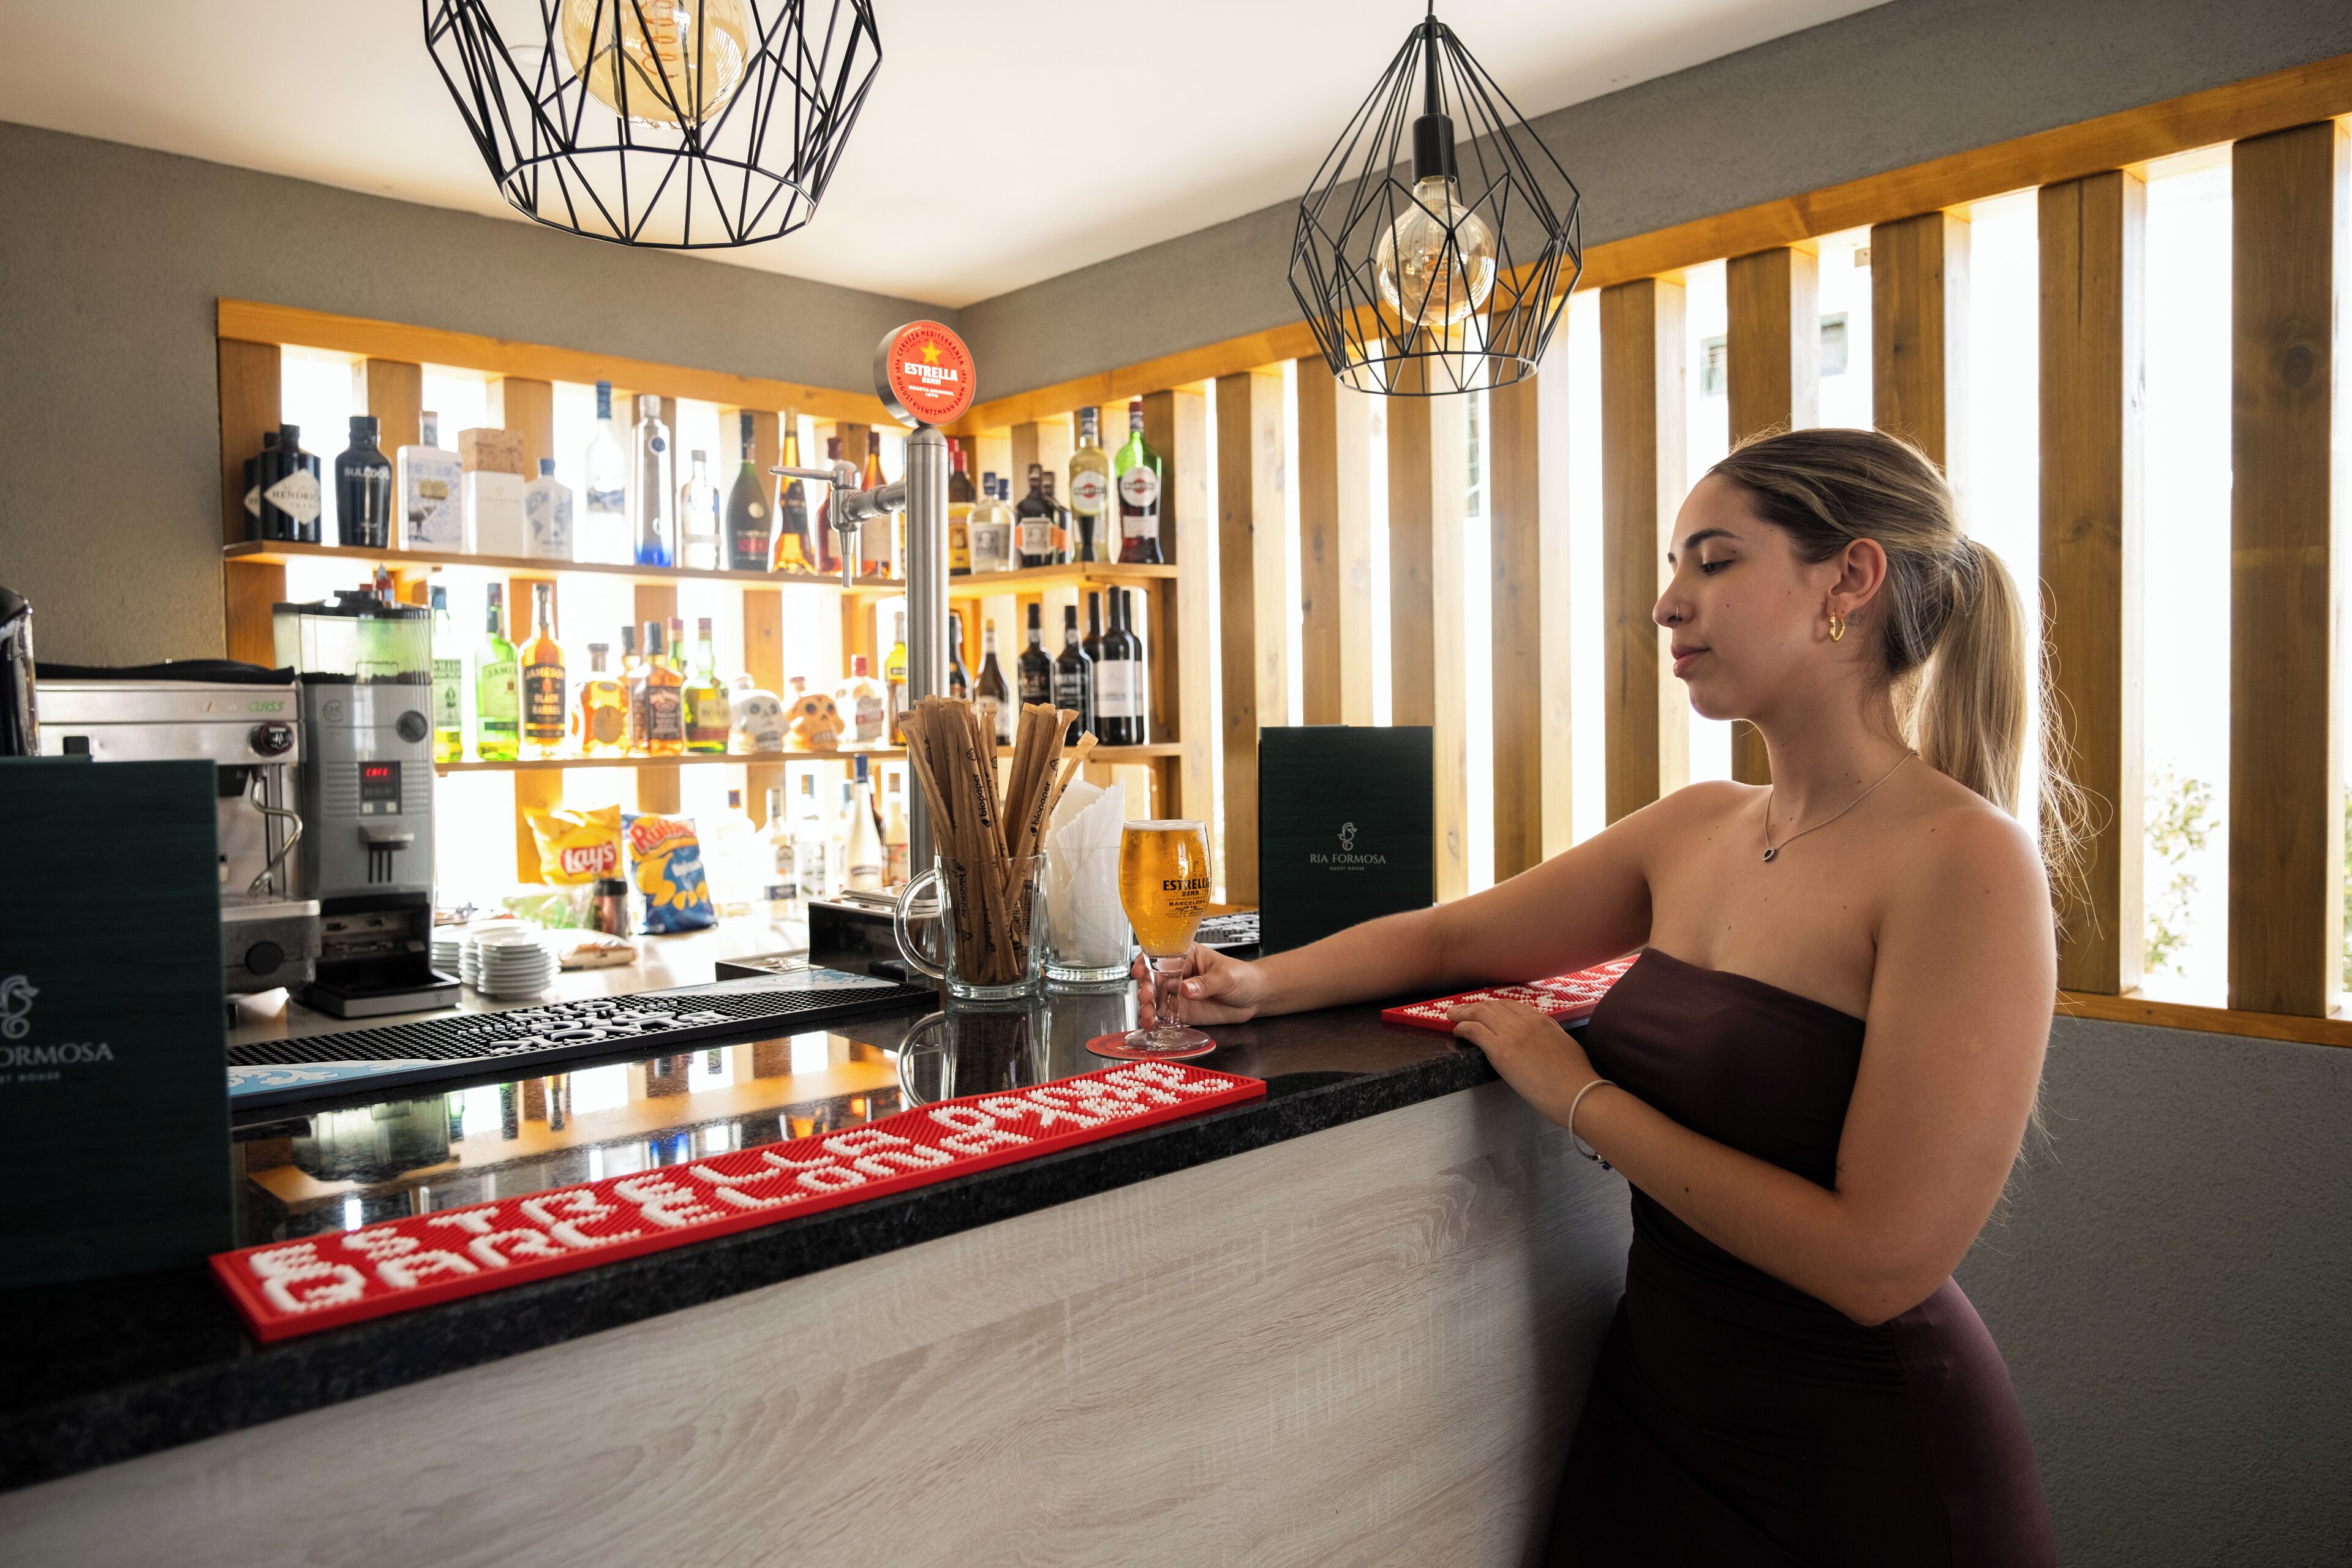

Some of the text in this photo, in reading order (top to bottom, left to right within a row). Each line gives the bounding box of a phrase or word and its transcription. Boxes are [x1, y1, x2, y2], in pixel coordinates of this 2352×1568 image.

[897, 332, 919, 356] CERVEZA
[904, 362, 958, 382] ESTRELLA
[921, 377, 941, 385] DAMM
[896, 375, 913, 403] AUGUST
[913, 401, 956, 416] KUENTZMANN
[954, 387, 967, 407] DAMM
[929, 388, 955, 396] ORIGINAL
[973, 773, 987, 818] biopaper
[1033, 780, 1052, 826] biopaper
[564, 842, 615, 875] Lay's
[1332, 853, 1386, 864] FORMOSA
[506, 1001, 617, 1021] GIN
[490, 1011, 734, 1055] BLACK
[248, 1062, 1186, 1278] ESTRELLA DAMM
[262, 1077, 1235, 1313] BARCELONA 1876
